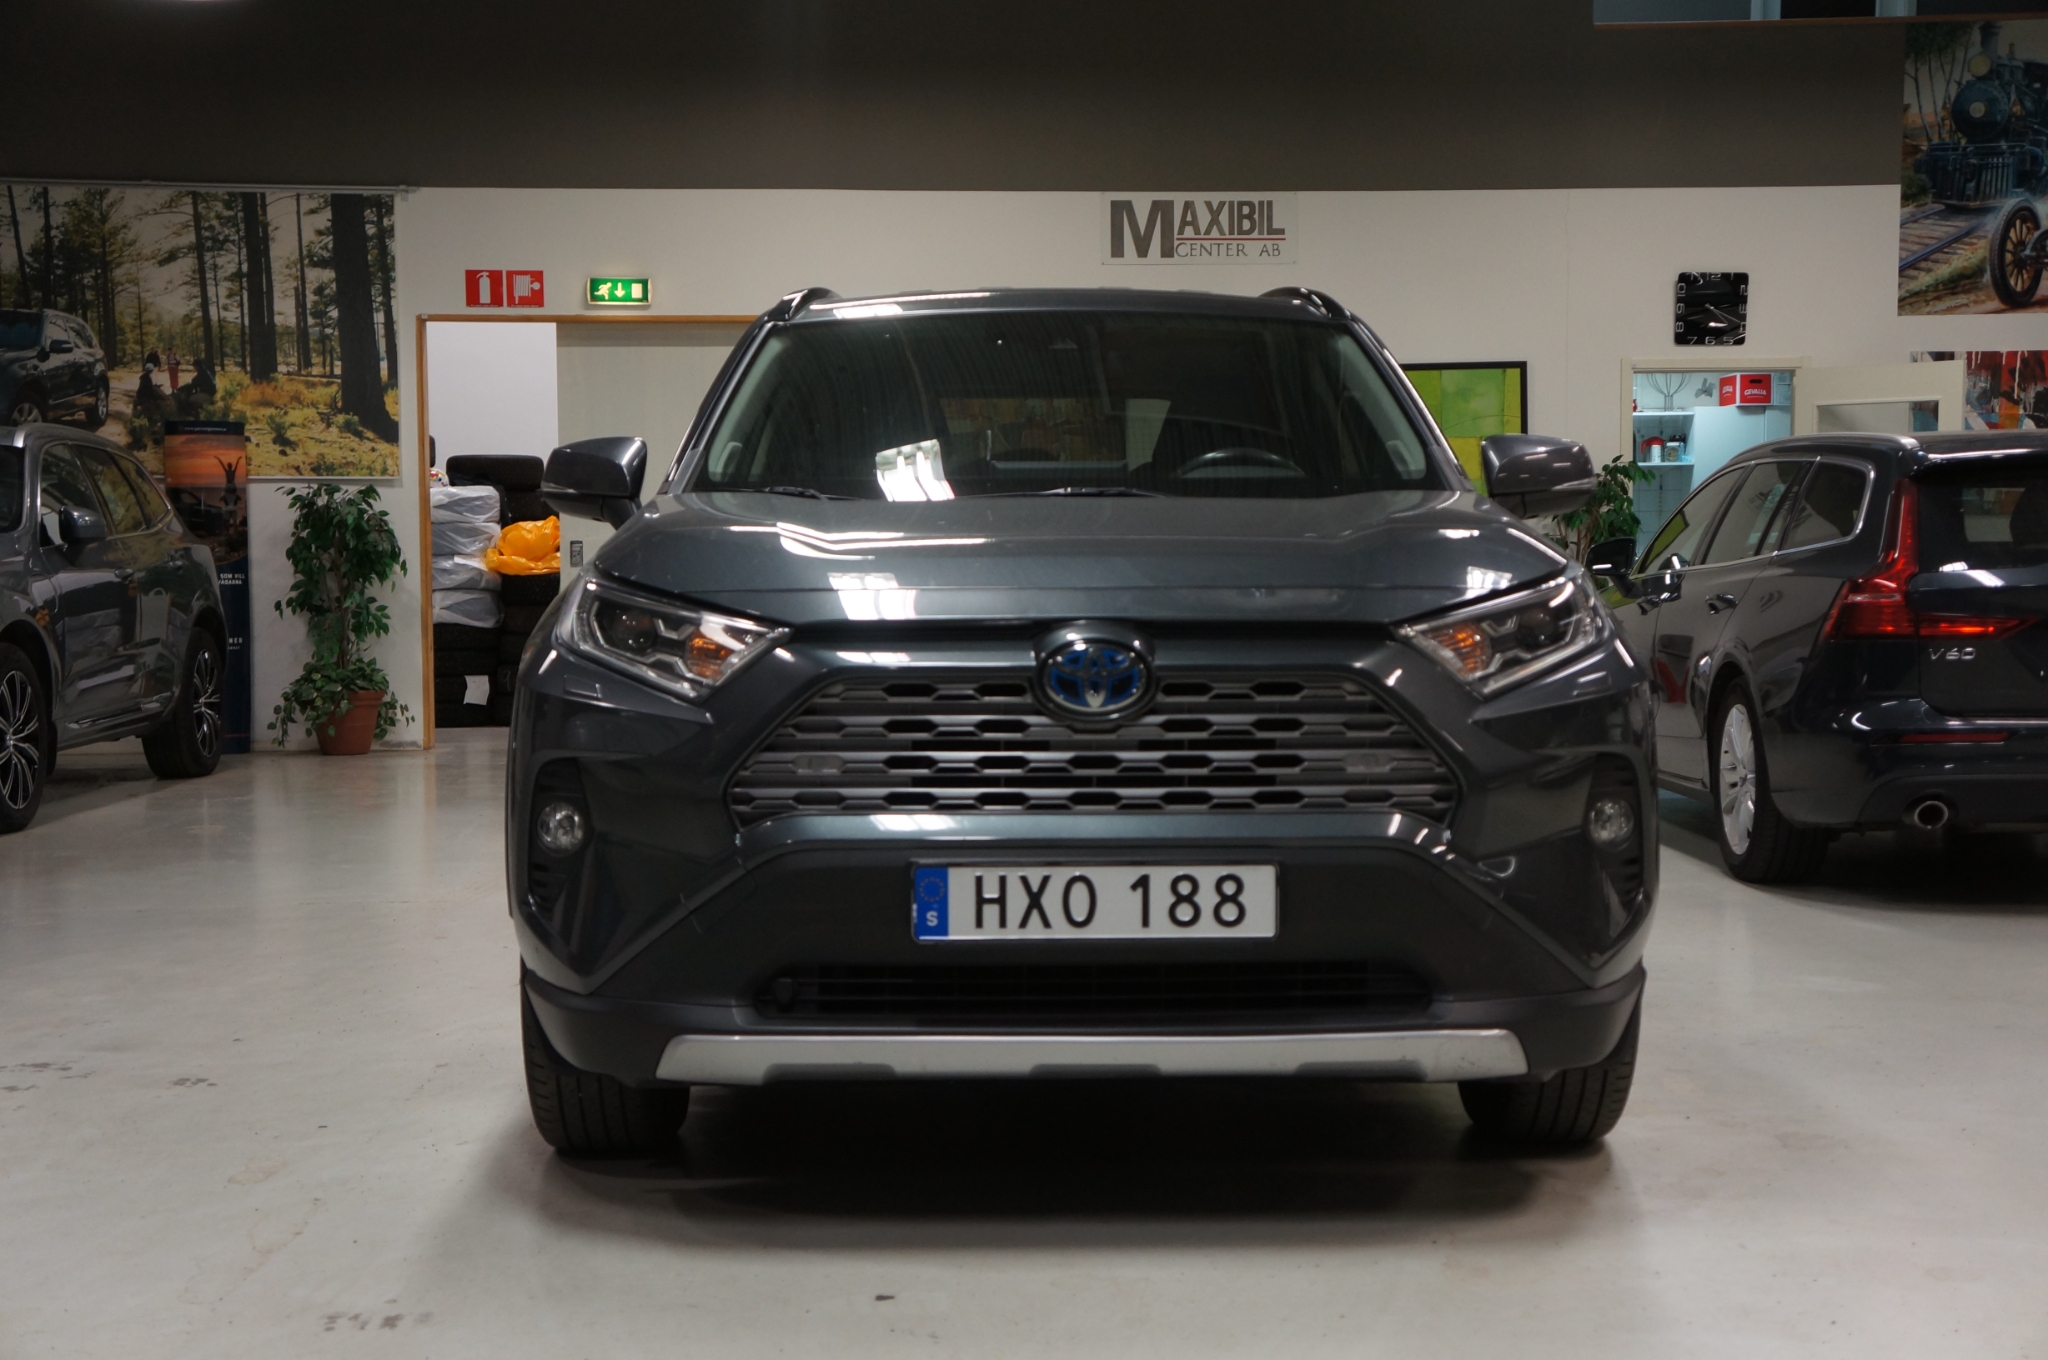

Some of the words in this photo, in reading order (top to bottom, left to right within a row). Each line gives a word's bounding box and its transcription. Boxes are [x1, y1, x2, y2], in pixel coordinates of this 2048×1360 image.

[1110, 199, 1286, 258] MAXIBIL
[1175, 242, 1248, 258] CENTER
[1259, 243, 1281, 257] AB
[1686, 336, 1698, 345] 7
[1705, 336, 1716, 345] 6
[1723, 336, 1734, 345] 5
[1928, 647, 1976, 660] V60
[974, 873, 1098, 929] HXO
[1129, 873, 1246, 928] 188
[926, 911, 939, 927] S
